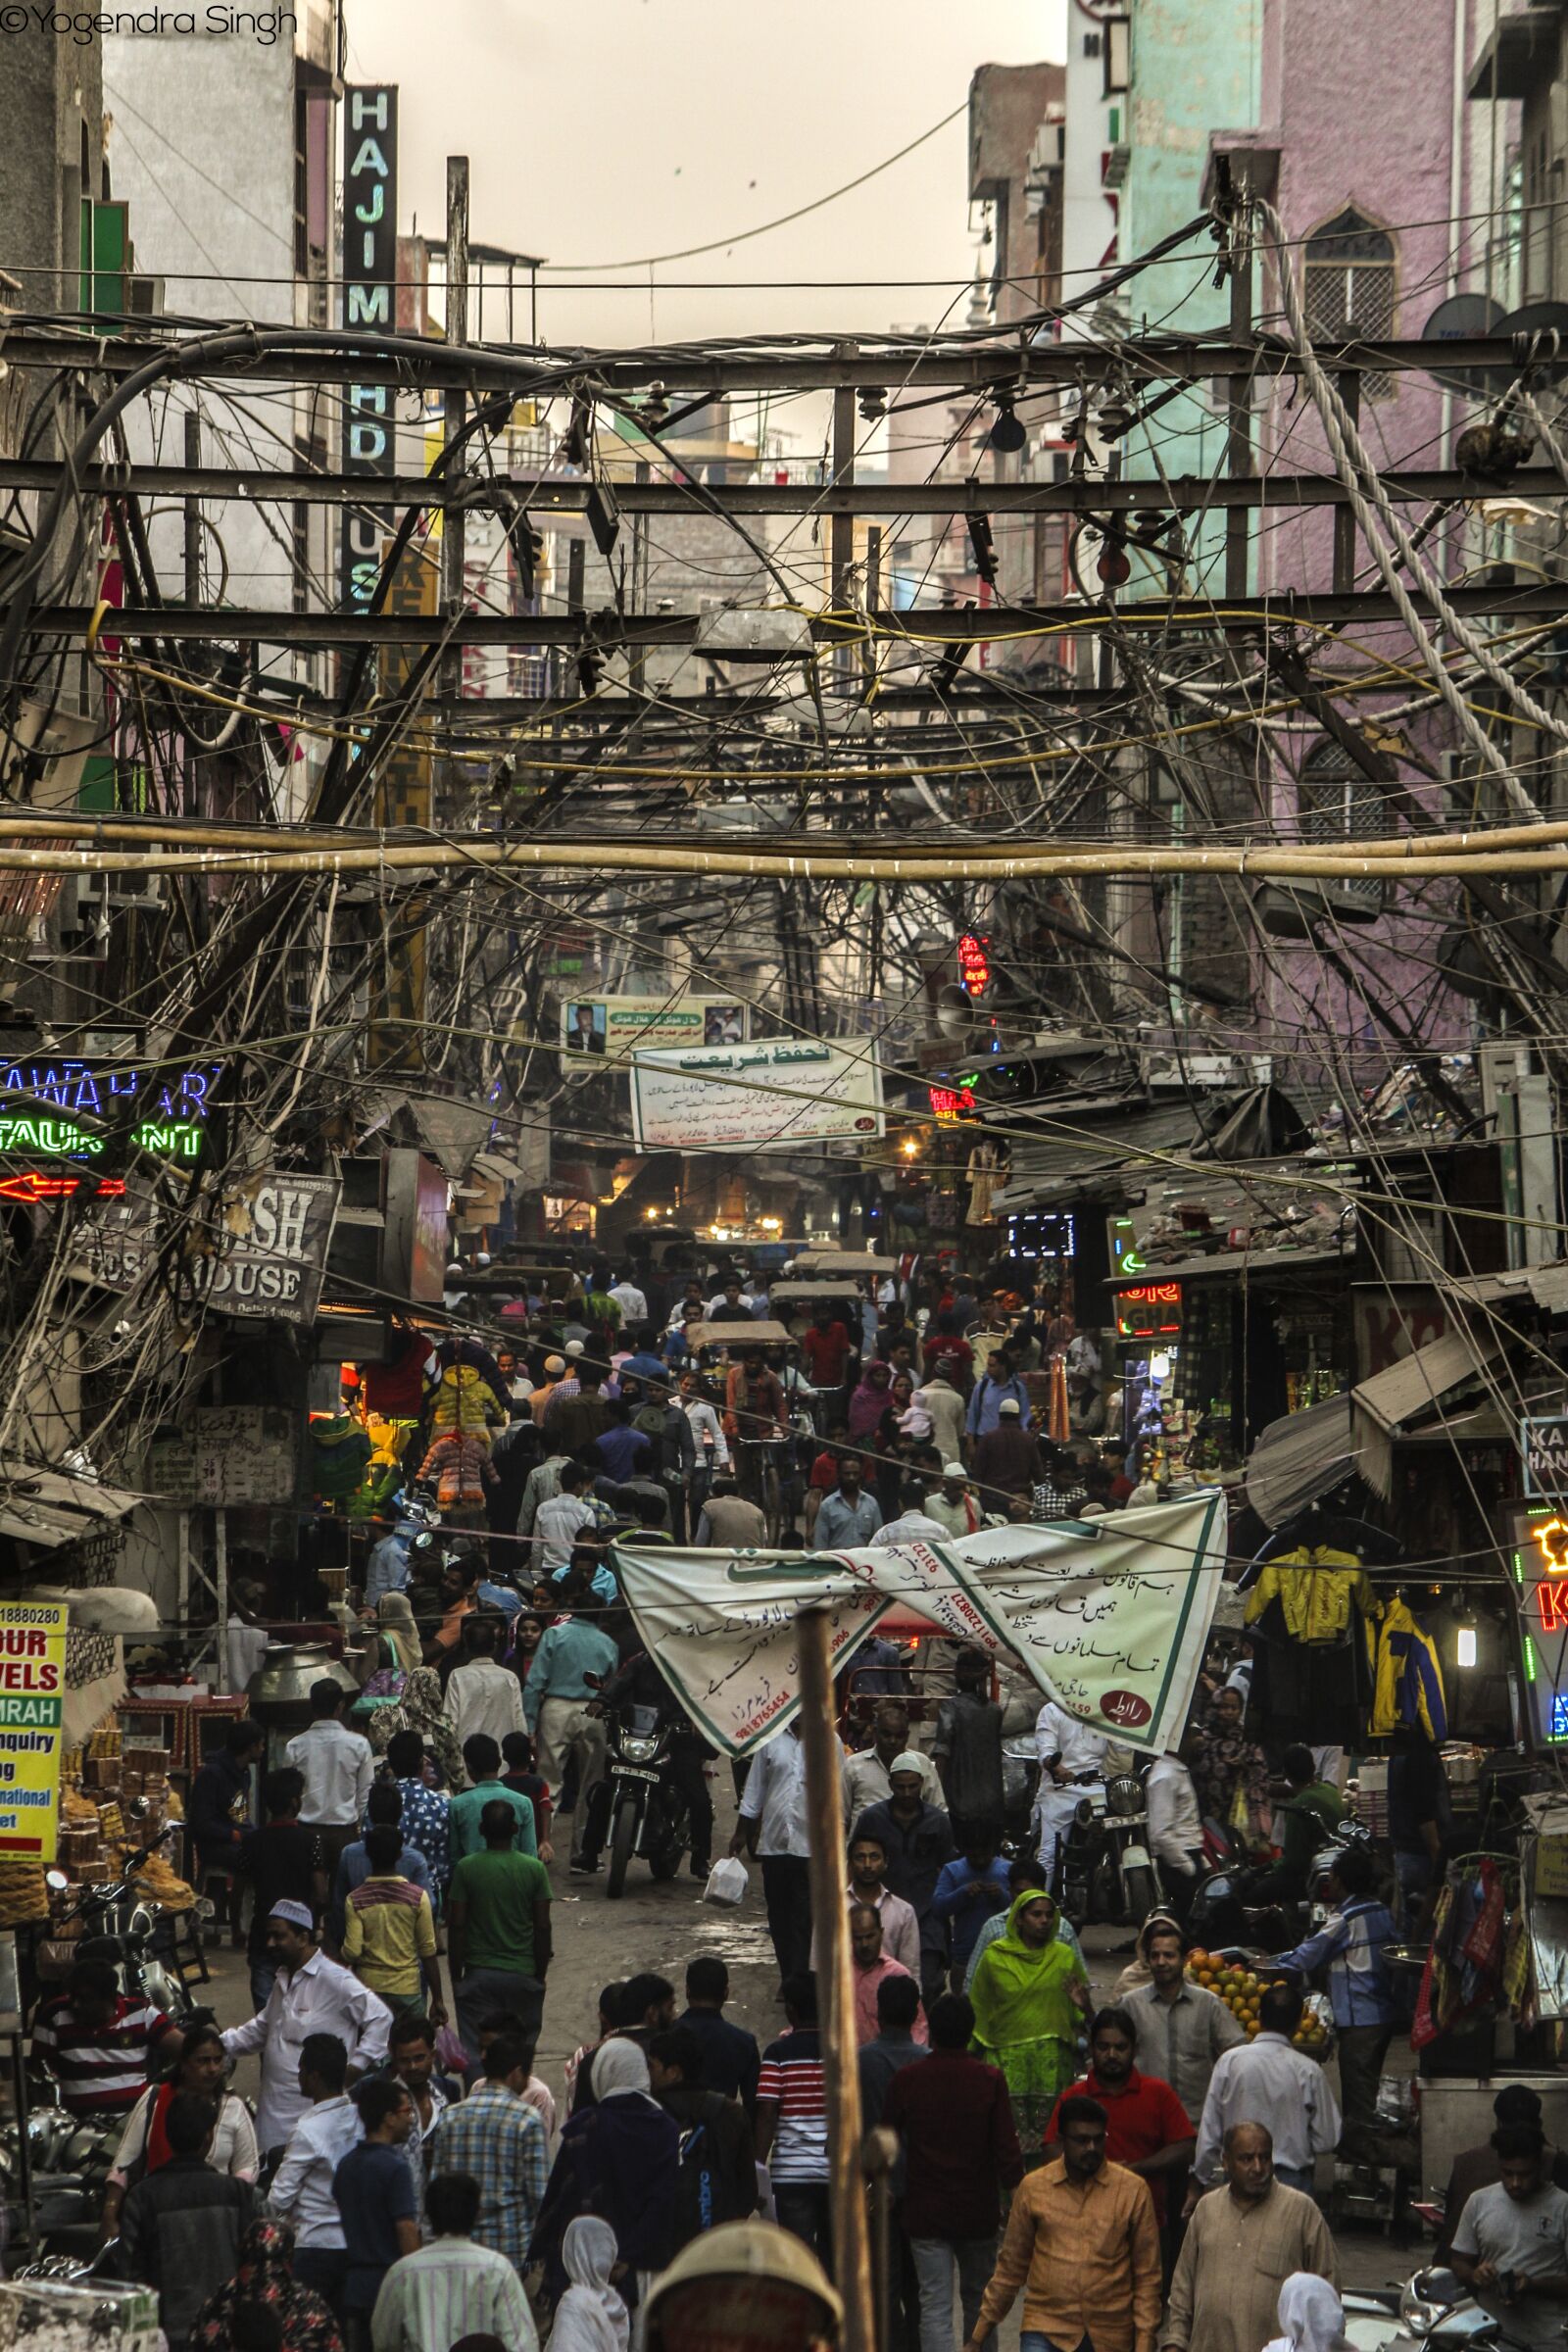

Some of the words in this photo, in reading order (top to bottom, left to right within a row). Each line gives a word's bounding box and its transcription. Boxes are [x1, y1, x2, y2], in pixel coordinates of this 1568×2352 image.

[351, 92, 387, 269] HAJI
[348, 284, 389, 460] MHD
[680, 1047, 769, 1072] شریعت
[772, 1044, 830, 1064] تحفظ
[0, 1629, 47, 1656] UR
[0, 1663, 59, 1690] ELS
[736, 1690, 791, 1740] 9818765454
